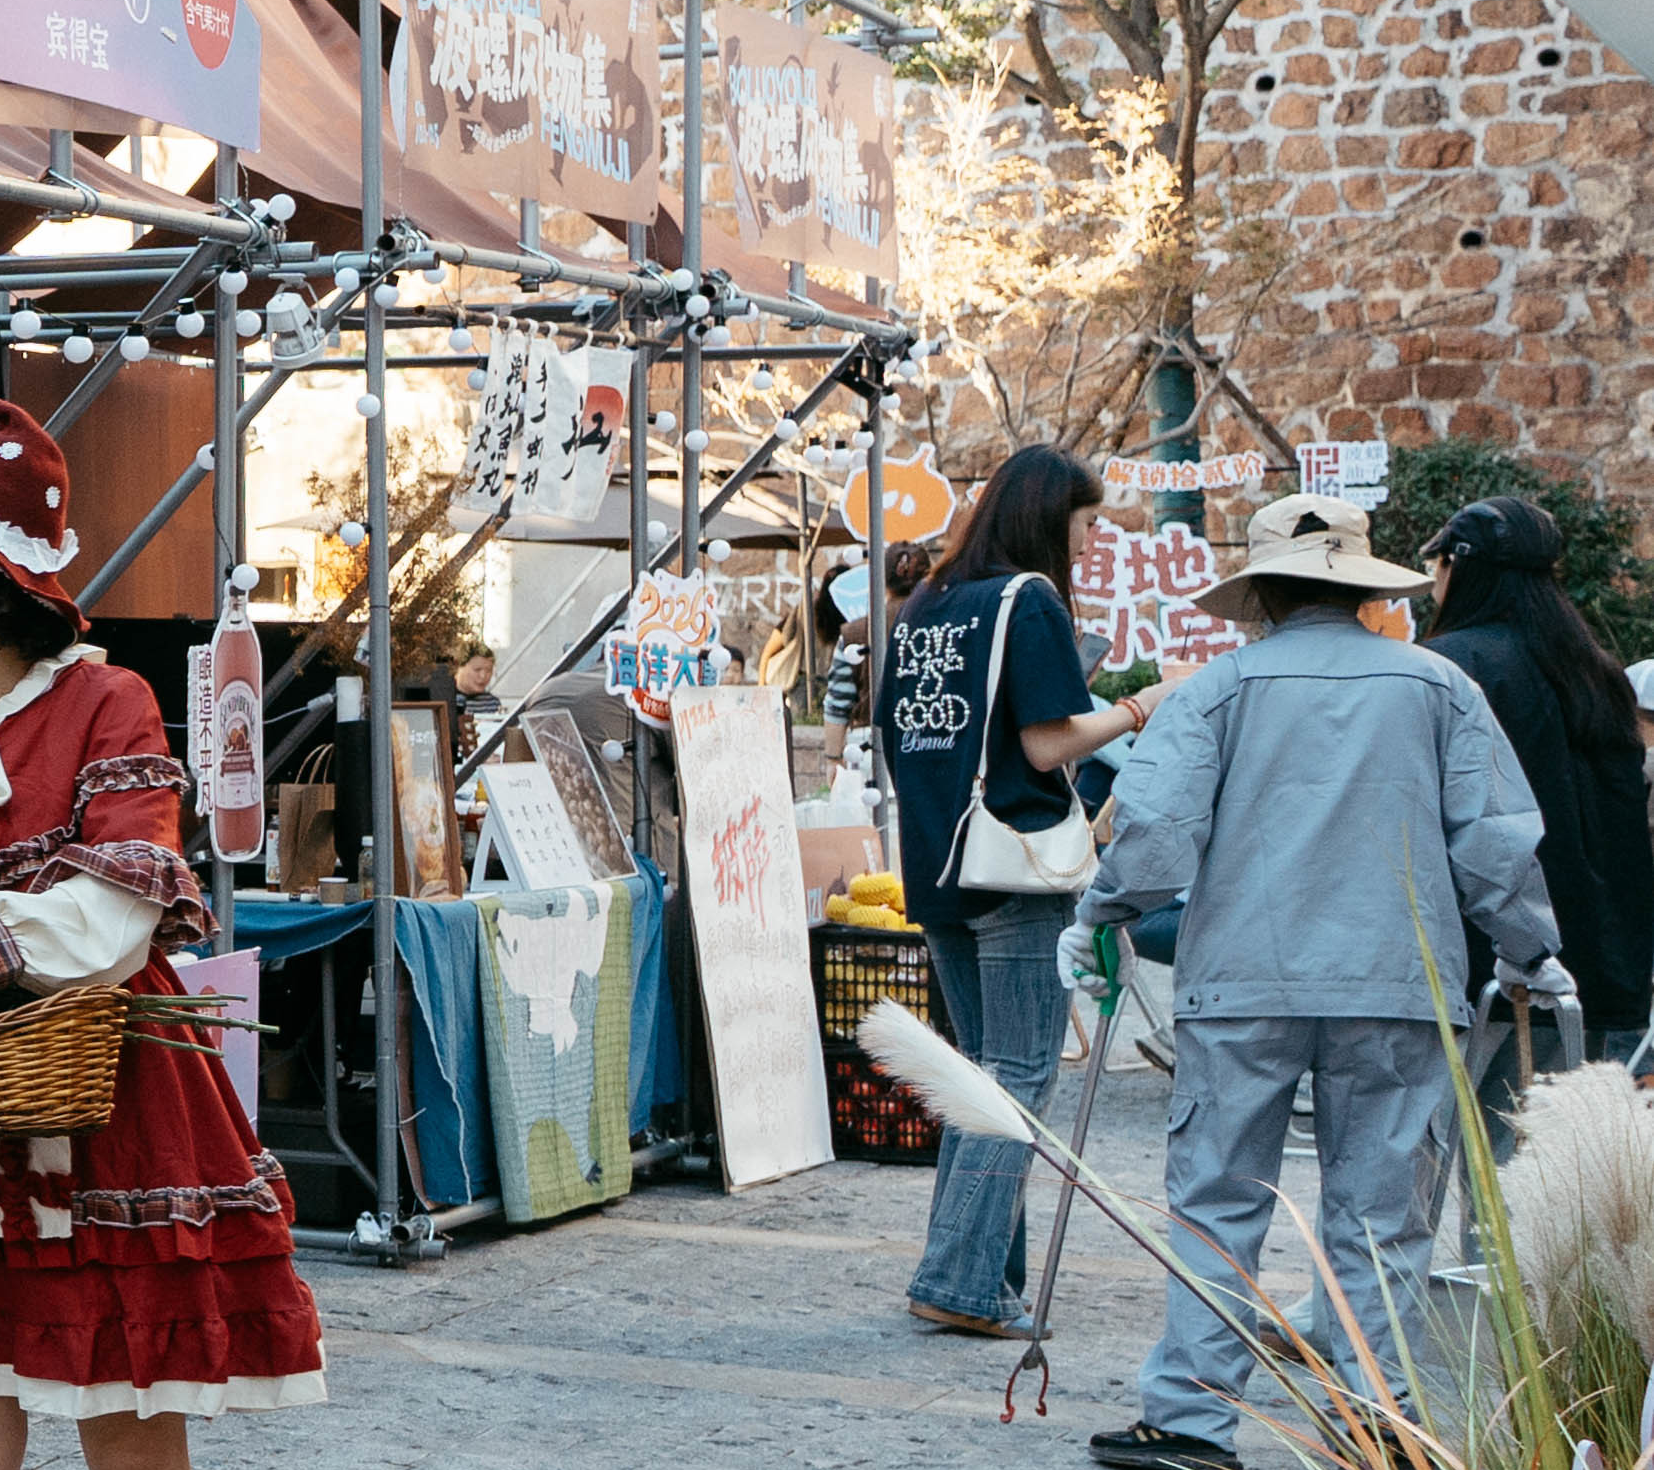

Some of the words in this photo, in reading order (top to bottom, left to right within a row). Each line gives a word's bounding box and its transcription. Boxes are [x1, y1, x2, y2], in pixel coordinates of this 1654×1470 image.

[46, 11, 109, 70] 宾得宝
[637, 580, 712, 647] 2026
[198, 650, 214, 812] 酿造不平凡
[894, 694, 970, 731] GOOD
[901, 729, 956, 753] Brand
